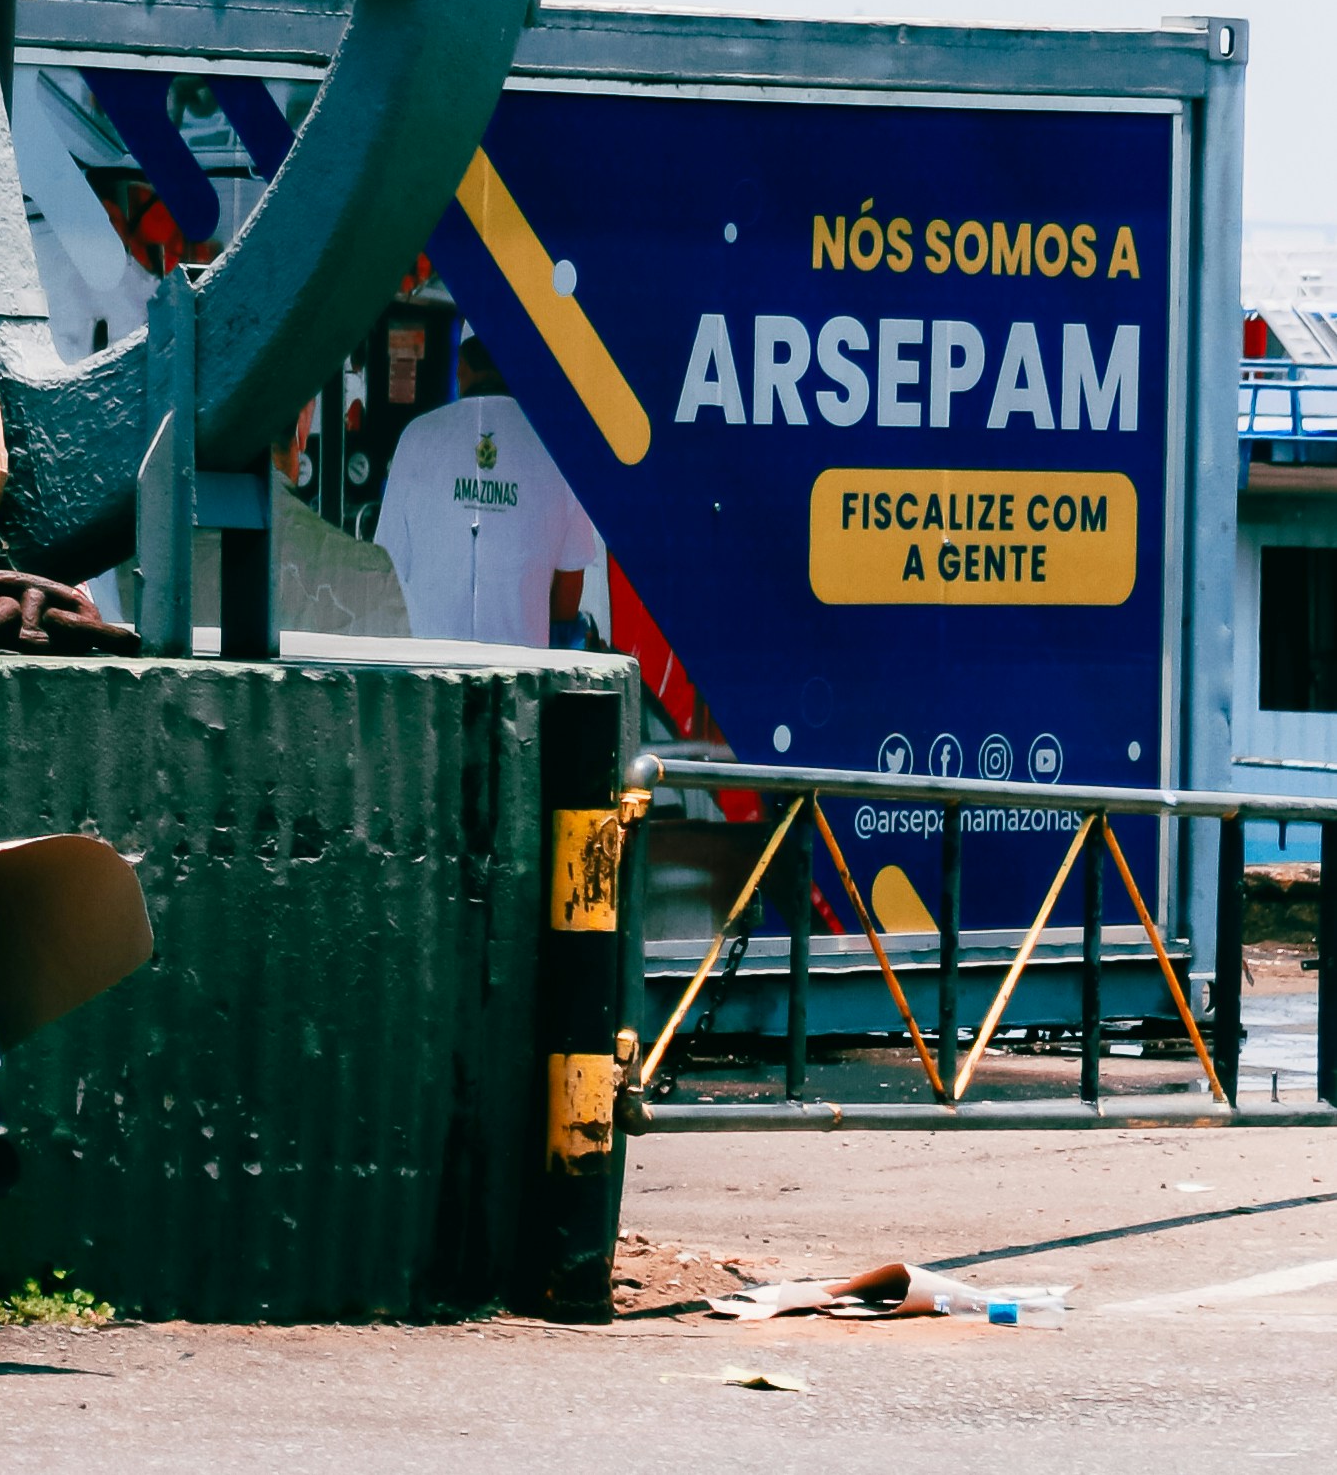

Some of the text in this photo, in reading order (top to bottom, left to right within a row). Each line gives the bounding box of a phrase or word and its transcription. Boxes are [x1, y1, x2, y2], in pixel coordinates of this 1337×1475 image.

[812, 197, 1140, 279] NÓS SOMOS A
[674, 313, 1141, 431] ARSEPAM
[453, 477, 519, 506] AMAZONAS
[842, 492, 1108, 532] FISCALIZE COM
[902, 544, 1047, 582] A GENTE
